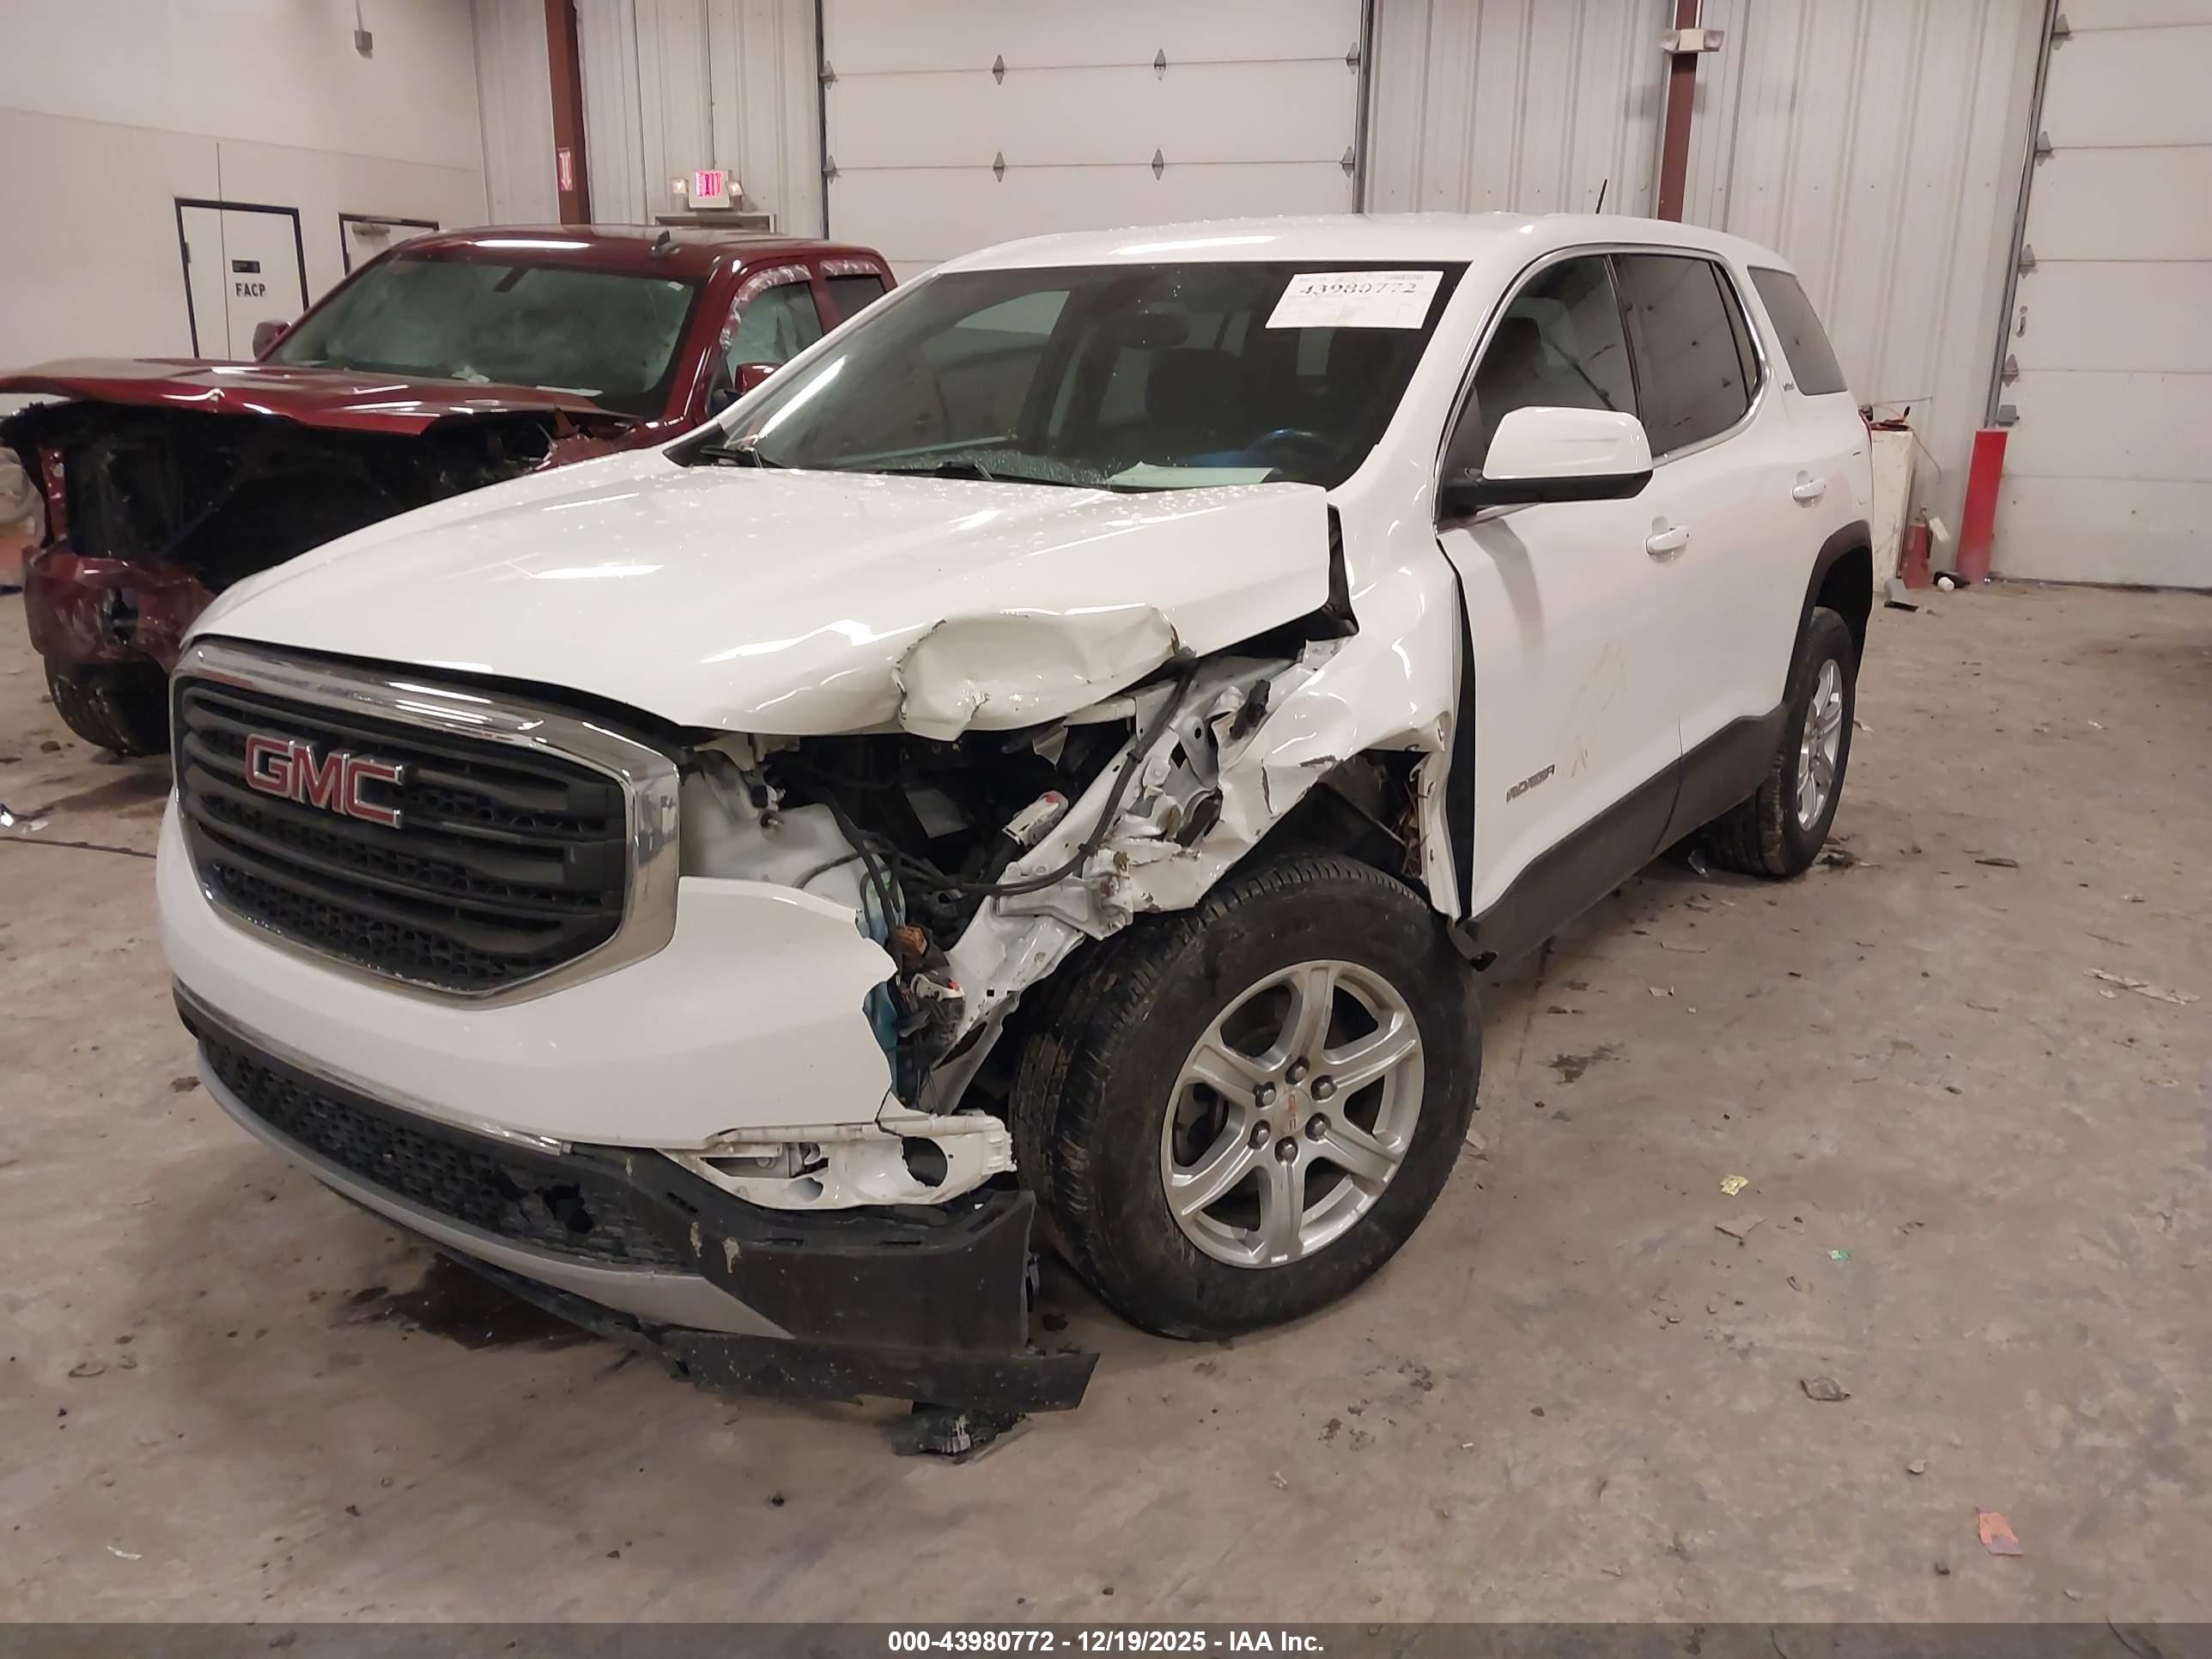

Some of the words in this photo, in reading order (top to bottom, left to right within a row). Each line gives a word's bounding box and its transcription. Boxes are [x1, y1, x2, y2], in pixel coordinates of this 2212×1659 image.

[696, 171, 722, 198] EXIT
[234, 283, 265, 297] FACP
[246, 733, 404, 830] GMC
